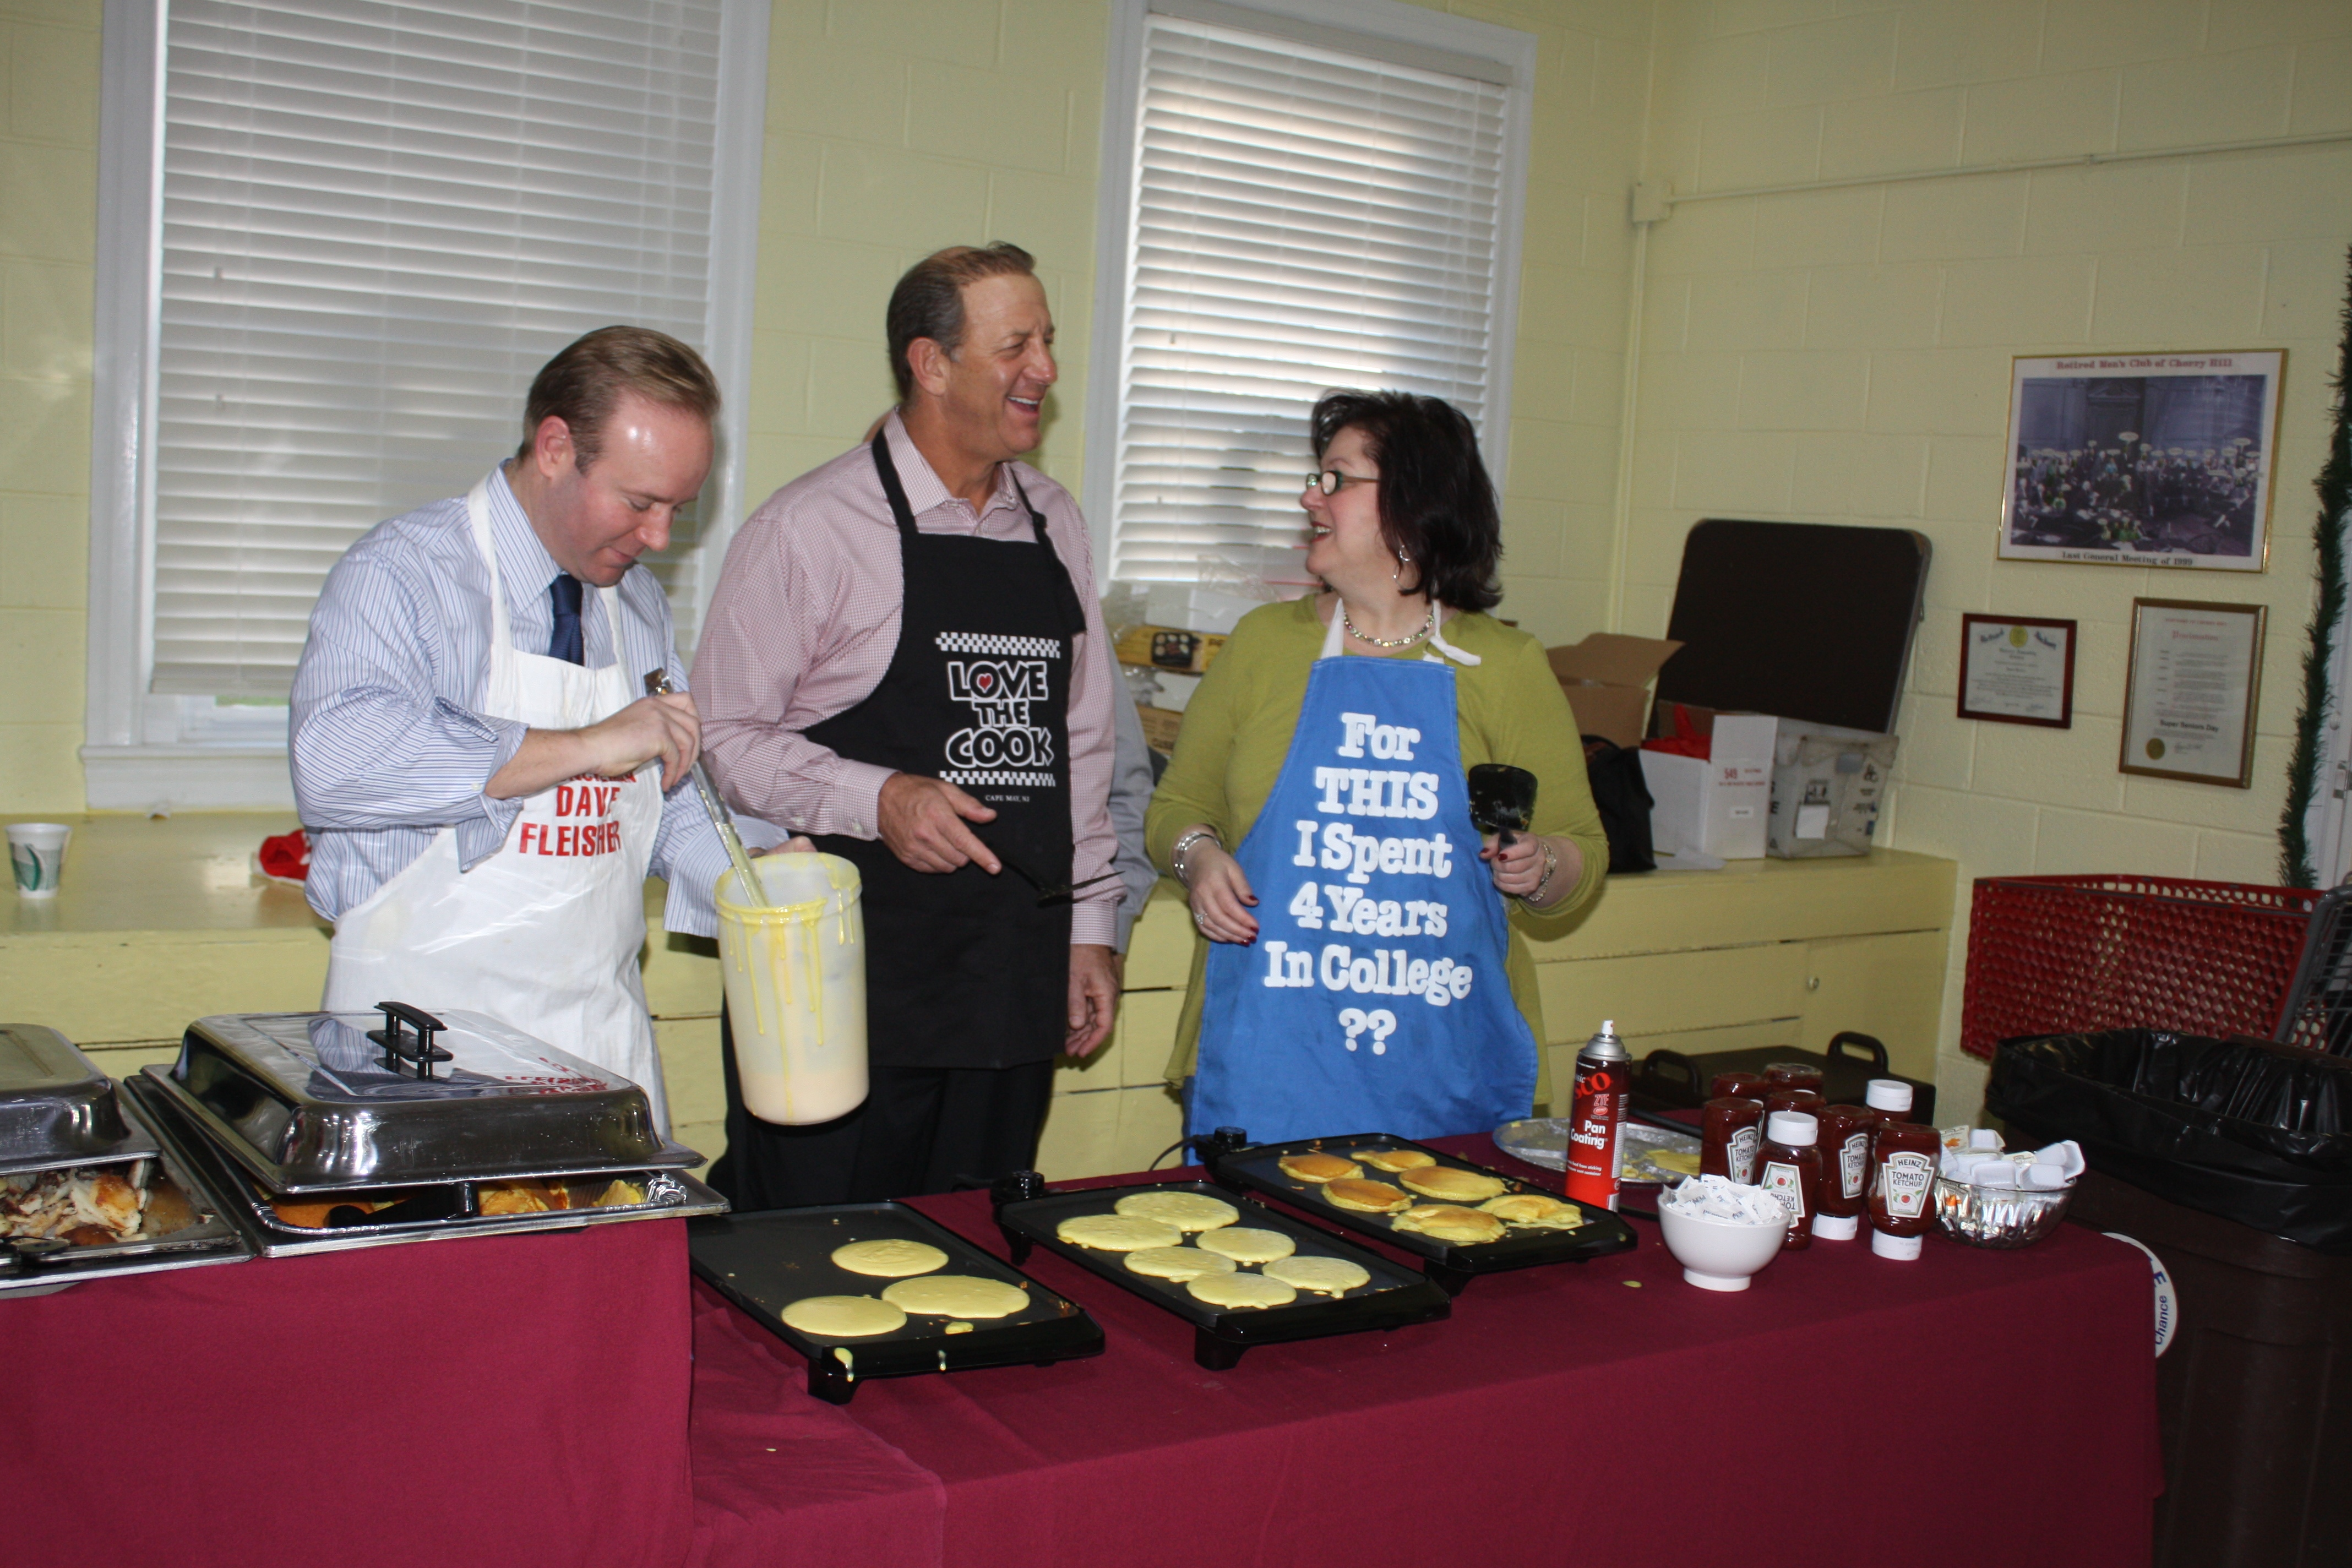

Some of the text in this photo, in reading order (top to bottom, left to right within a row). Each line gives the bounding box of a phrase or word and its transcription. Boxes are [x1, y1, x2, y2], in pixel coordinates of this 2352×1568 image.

[2057, 361, 2094, 369] Retired
[2130, 360, 2152, 368] Club
[2169, 360, 2206, 369] Cherry
[2209, 358, 2233, 367] Hill
[2083, 552, 2118, 561] General
[2122, 554, 2157, 565] Meeting
[948, 660, 1048, 701] LOVE
[972, 698, 1030, 728] THE
[945, 726, 1054, 769] COOK
[1338, 712, 1420, 760] For
[1316, 766, 1439, 820] THIS
[1294, 820, 1453, 884] I Spent
[1289, 881, 1448, 937] 4 Years
[1264, 941, 1473, 1006] In College
[1338, 1008, 1397, 1055] ??
[1570, 1128, 1606, 1150] Coating
[1584, 1119, 1606, 1134] Pan
[1892, 1171, 1924, 1182] TOMATO
[1897, 1158, 1922, 1168] HEINZ
[1892, 1178, 1923, 1188] KETCHUP
